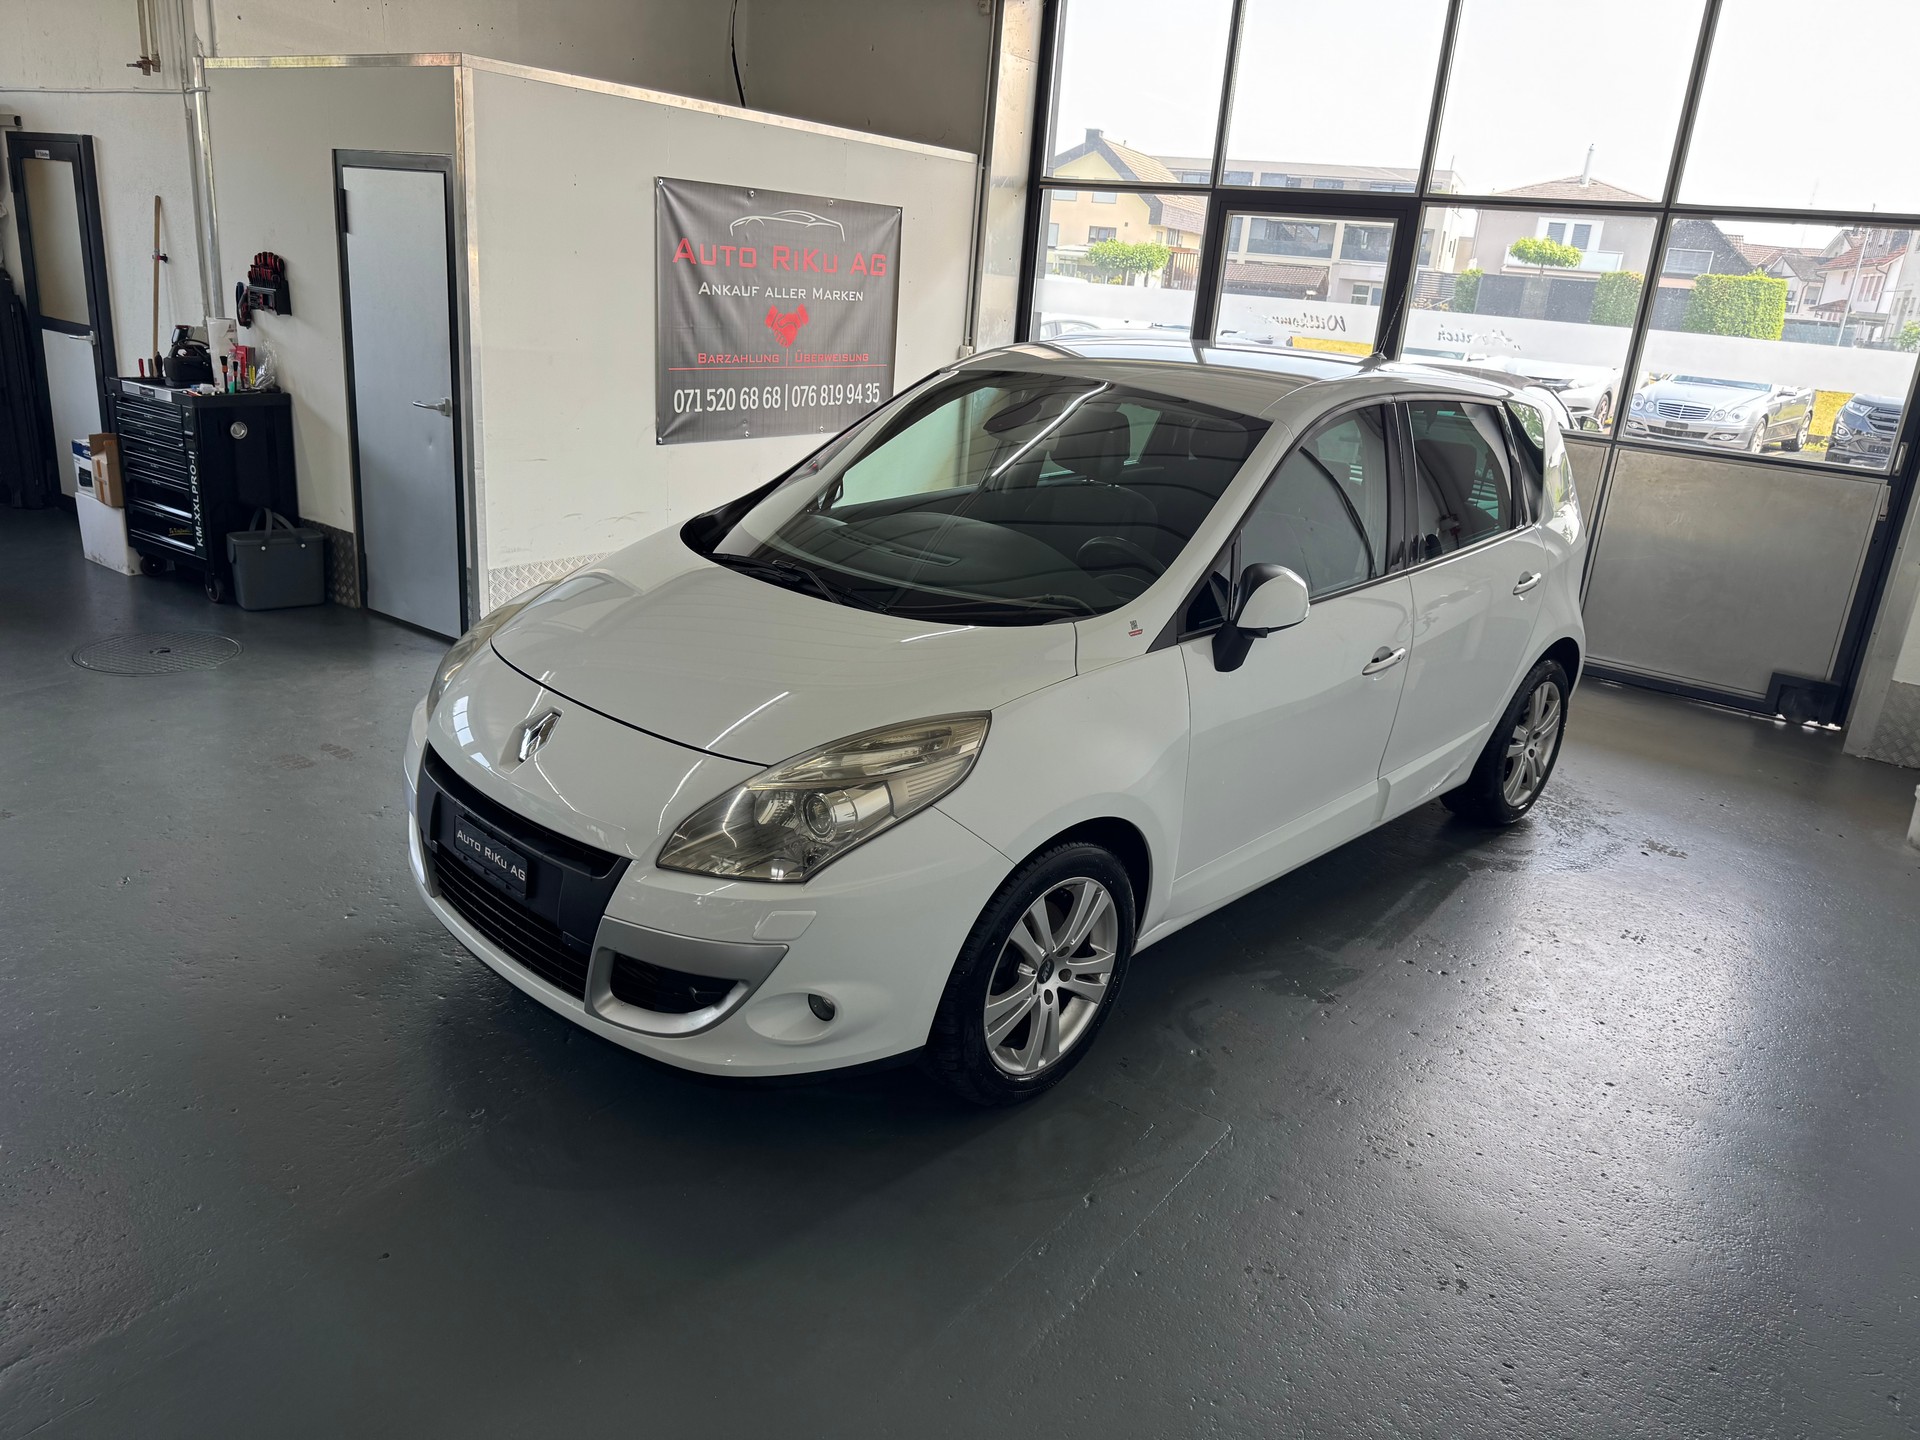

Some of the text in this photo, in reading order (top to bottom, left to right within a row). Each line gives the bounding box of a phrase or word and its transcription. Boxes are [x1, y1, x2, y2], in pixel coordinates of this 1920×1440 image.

[850, 252, 887, 277] AG
[698, 281, 864, 302] ANKAUF ALLER MARKEN
[697, 352, 780, 364] BARZAHLUNG
[673, 382, 880, 413] 071 520 68 68 076 819 94 35
[456, 830, 481, 852] AUTO
[510, 864, 526, 882] AG
